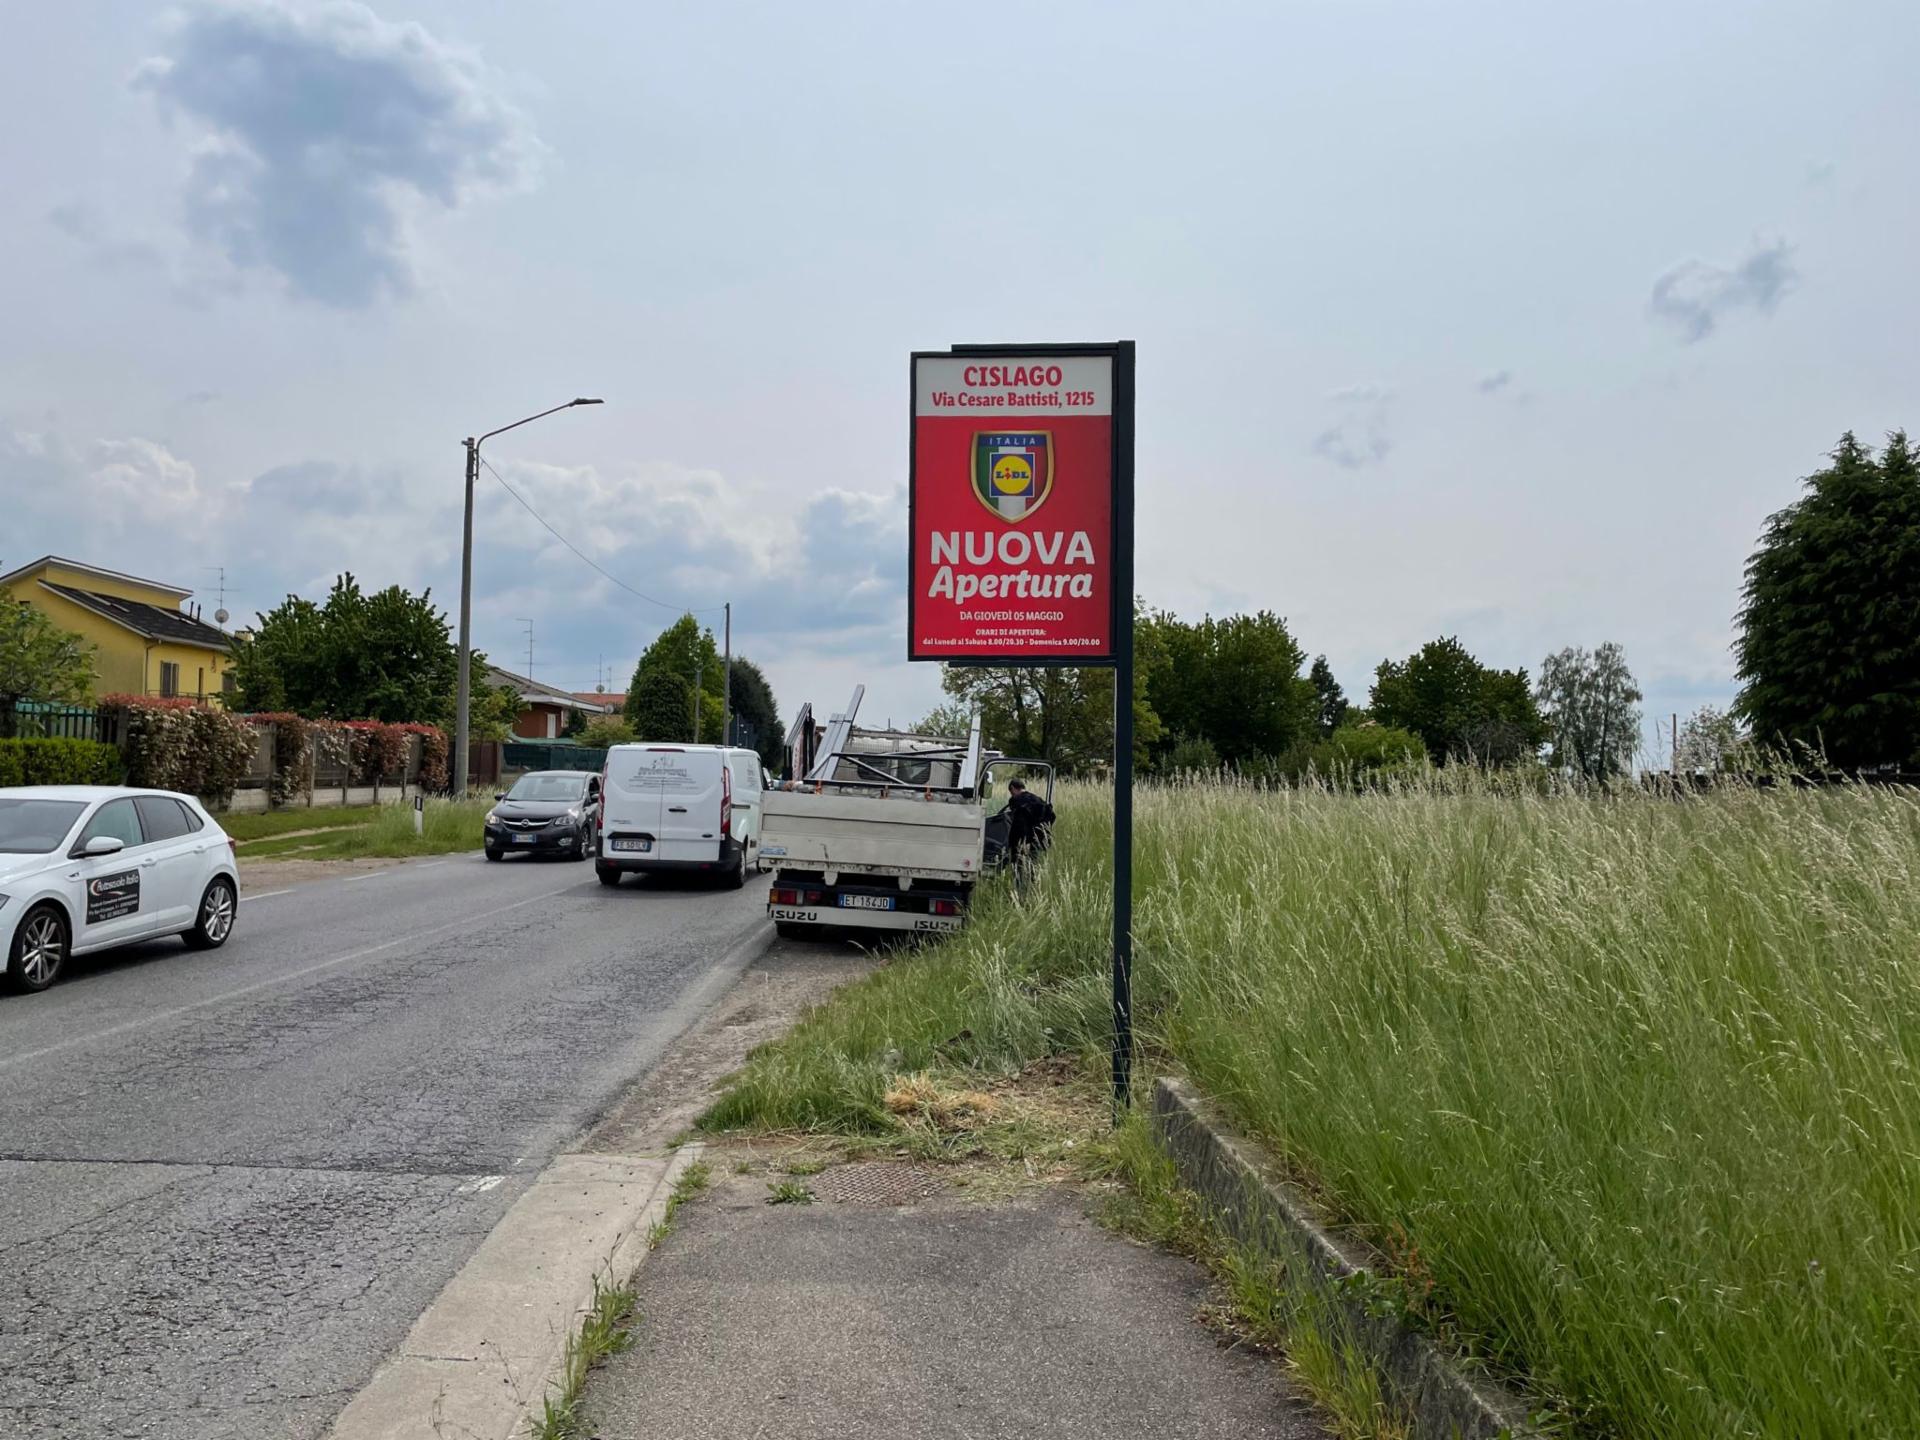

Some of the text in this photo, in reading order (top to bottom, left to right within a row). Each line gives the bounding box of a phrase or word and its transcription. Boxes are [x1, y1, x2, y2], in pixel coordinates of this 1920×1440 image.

[964, 366, 1063, 387] CISLAGO
[932, 391, 1095, 408] Via Cesare Battisti, 1215
[989, 437, 1036, 446] ITALIA
[931, 531, 1095, 565] NUOVA
[928, 565, 1093, 605] Apertura
[960, 609, 1064, 621] DA GIOVEDÌ 05 MAGGIO
[976, 628, 1047, 636] ORARI DI APERTURA:
[923, 637, 933, 645] dal
[958, 637, 964, 645] al
[965, 637, 987, 645] Sabato
[987, 637, 1024, 647] 8.00/20.30
[1029, 637, 1062, 646] Domenica
[1062, 637, 1100, 647] 9.00/20.00
[845, 895, 857, 906] ET
[771, 909, 818, 921] ISUZU
